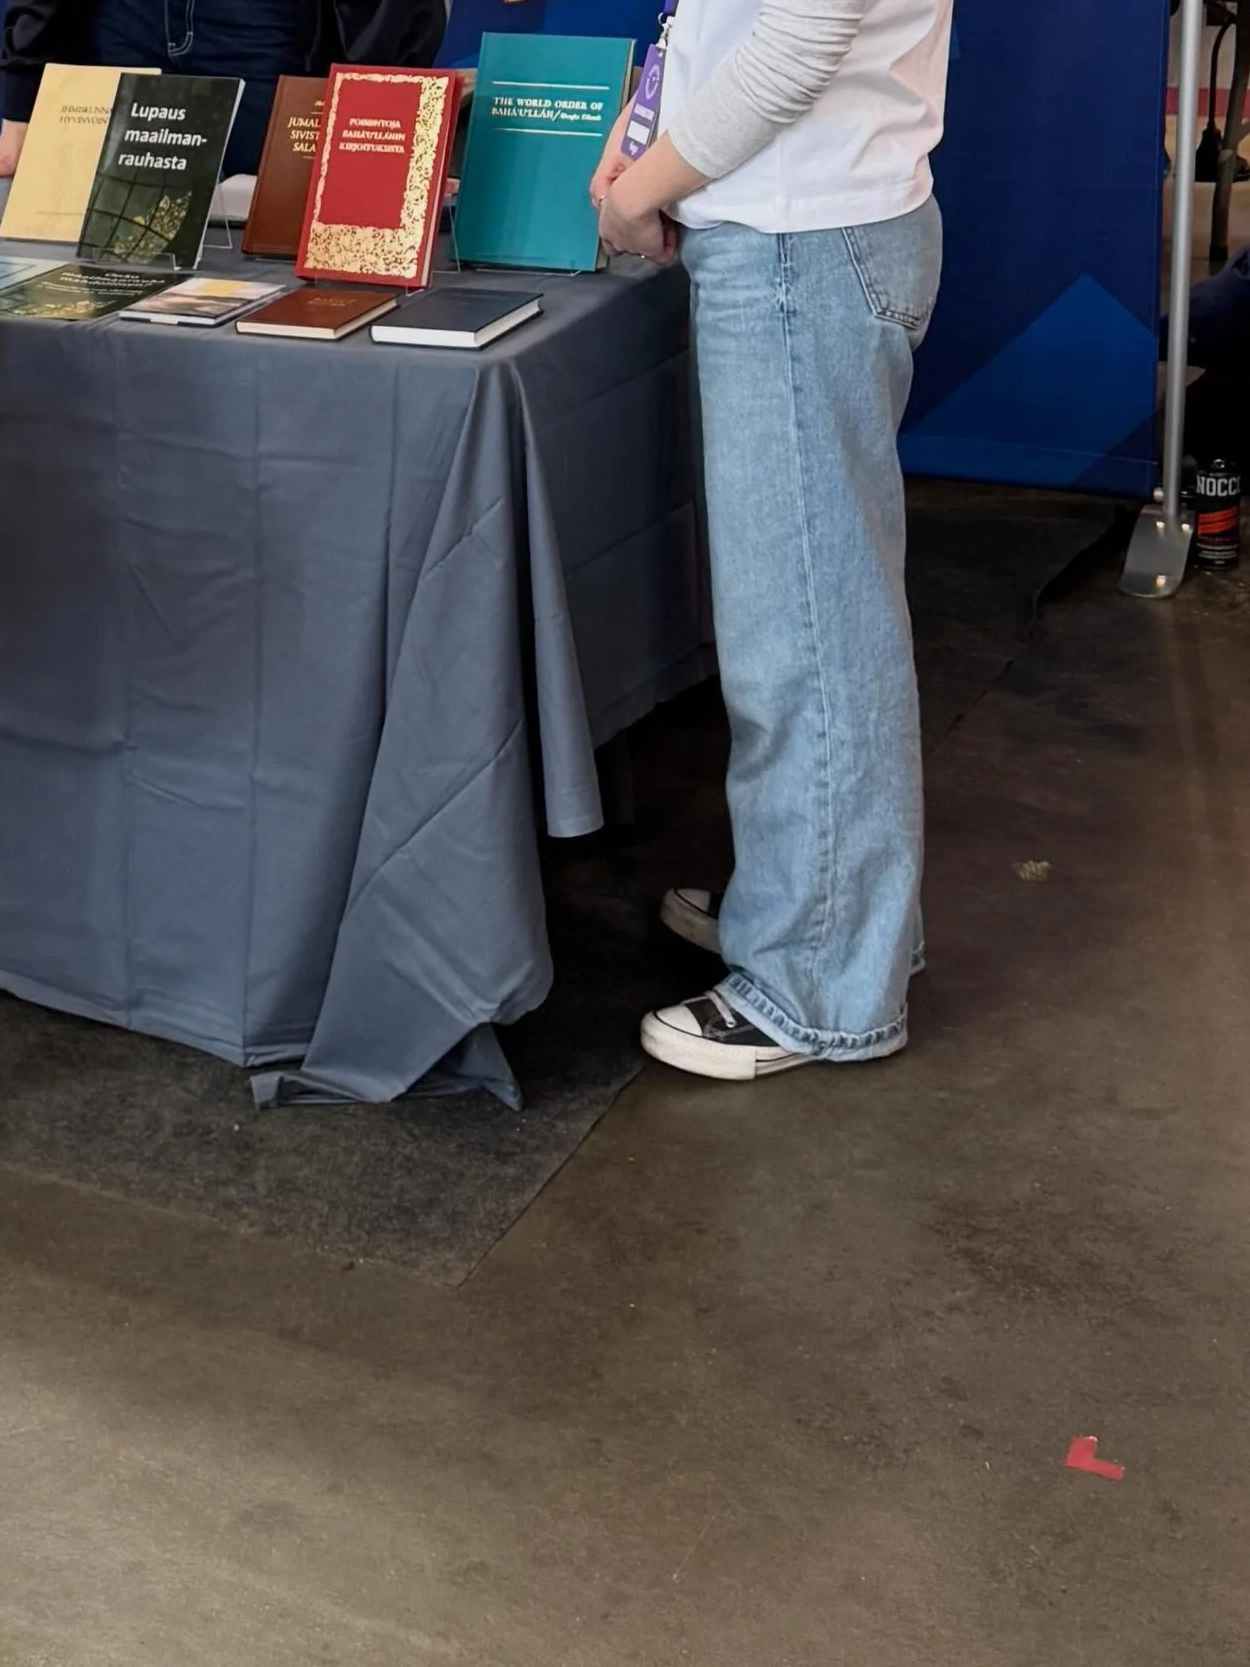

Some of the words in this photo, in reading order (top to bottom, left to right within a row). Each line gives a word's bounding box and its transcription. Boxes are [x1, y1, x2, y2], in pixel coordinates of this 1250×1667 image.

[130, 102, 187, 123] Lupaus
[494, 96, 513, 106] THE
[517, 98, 552, 109] WORLD
[554, 100, 588, 111] ORDER
[590, 101, 604, 111] OF
[124, 127, 208, 147] maailman-
[117, 151, 187, 171] rauhasta
